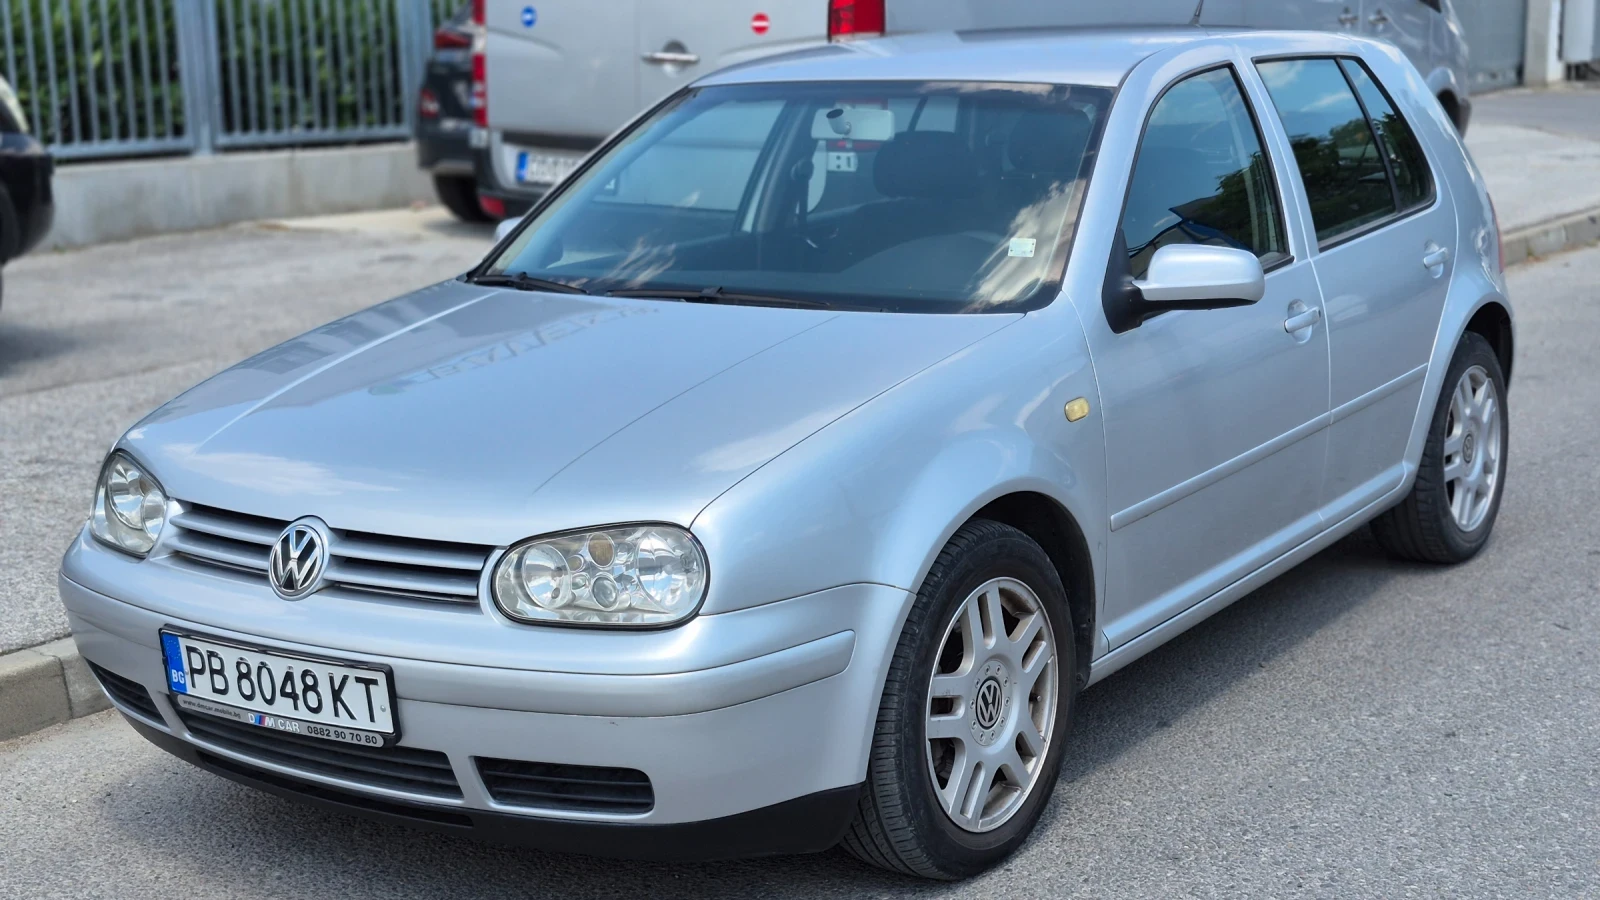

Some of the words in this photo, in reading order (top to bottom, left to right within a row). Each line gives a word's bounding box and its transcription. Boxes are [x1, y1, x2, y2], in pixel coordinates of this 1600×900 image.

[172, 669, 185, 684] BG
[185, 645, 229, 695] PB
[235, 656, 323, 714] 8048
[328, 672, 379, 723] KT
[277, 719, 301, 733] CAR
[307, 725, 331, 738] 0882
[334, 729, 347, 740] 90
[349, 732, 362, 743] 70
[364, 735, 378, 745] 80
